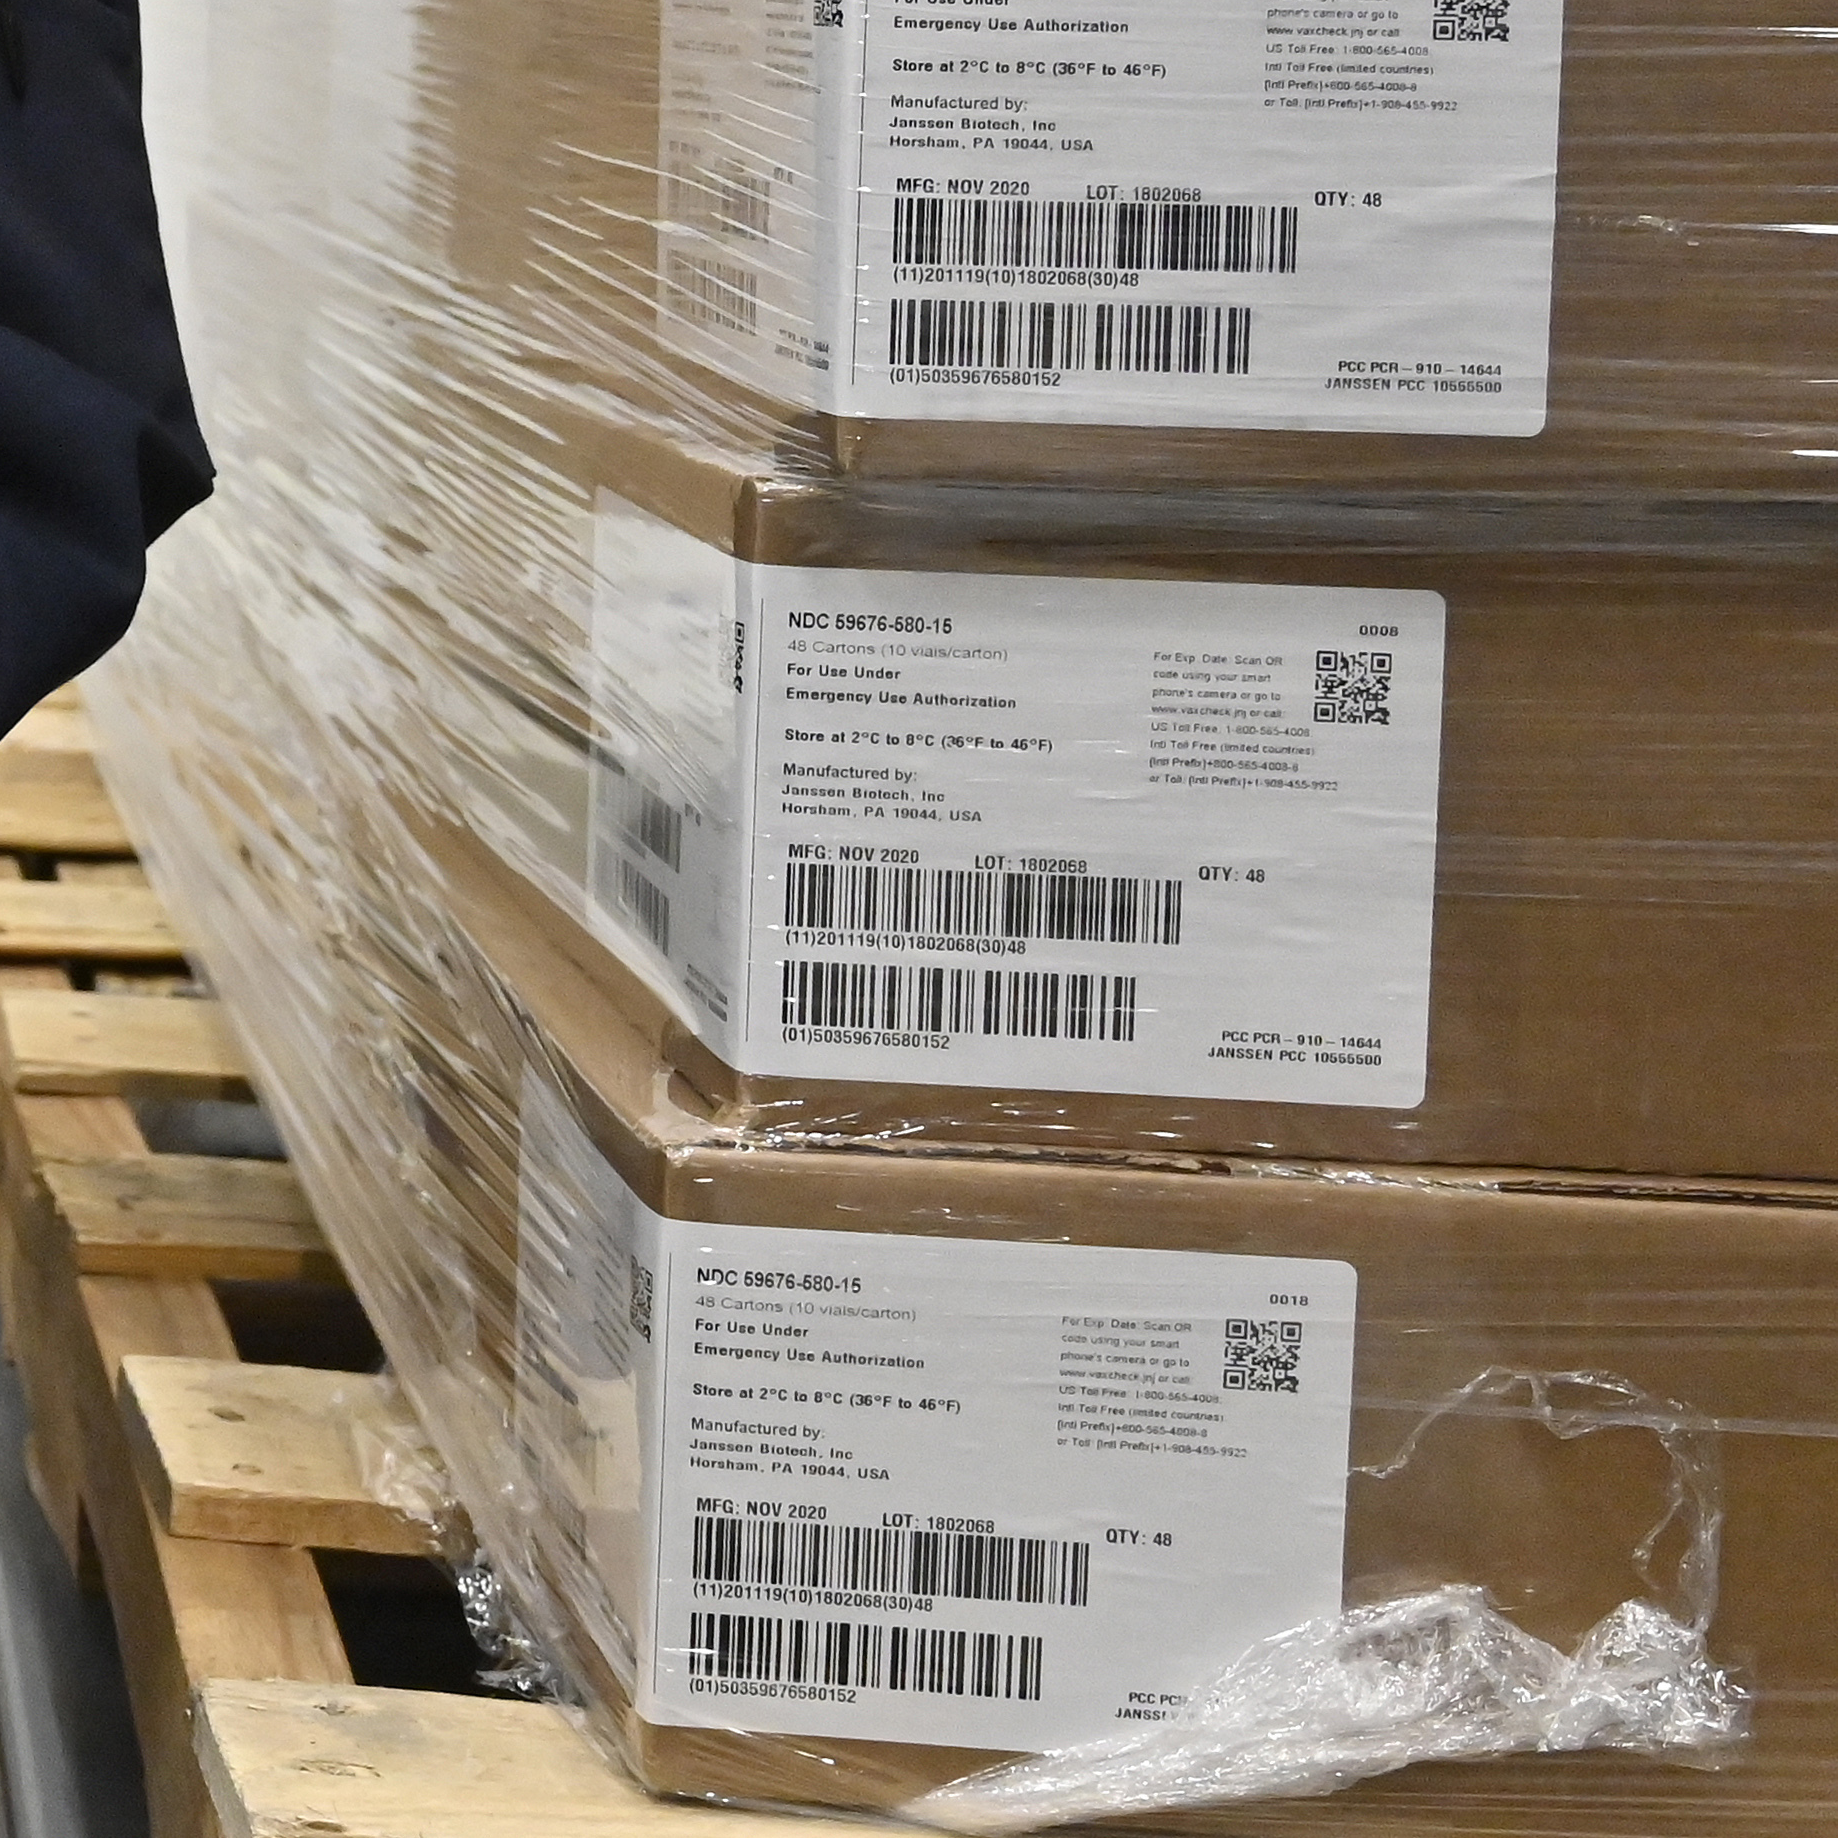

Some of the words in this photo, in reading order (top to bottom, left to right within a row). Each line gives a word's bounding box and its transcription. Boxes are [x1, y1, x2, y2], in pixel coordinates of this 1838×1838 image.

[894, 16, 980, 31] Emergency
[988, 18, 1016, 30] Use
[1024, 19, 1128, 32] Authorization
[892, 59, 932, 71] Store
[940, 61, 953, 72] at
[996, 62, 1009, 72] to
[1102, 64, 1115, 75] to
[891, 94, 998, 109] Manufactured
[889, 117, 953, 128] Janssen
[1033, 120, 1055, 131] Inc
[973, 138, 994, 148] PA
[1061, 139, 1092, 150] USA
[897, 178, 939, 192] MFG:
[948, 179, 983, 194] NOV
[990, 181, 1029, 195] 2020
[1087, 185, 1123, 200] LOT:
[1134, 187, 1200, 201] 1802068
[1315, 191, 1354, 206] QTY:
[1363, 193, 1381, 207] 48
[894, 266, 1138, 288] (11)201119(10)1802068(30)48
[1338, 361, 1365, 372] PCC
[1370, 362, 1398, 373] PCR
[1416, 363, 1441, 374] 910
[1461, 364, 1500, 375] 14644
[890, 368, 1060, 386] (01)50359676580152
[1325, 378, 1390, 389] JANSSEN
[1398, 379, 1424, 390] PCC
[789, 612, 828, 628] NDC
[835, 614, 951, 633] 59676-580-15
[1359, 625, 1398, 636] 0008
[783, 1026, 949, 1049] (01)50359676580152
[697, 1268, 737, 1285] NDC
[744, 1271, 860, 1293] 59676-580-15
[1270, 1294, 1308, 1305] 0018
[689, 1678, 856, 1703] (01)50359676580152
